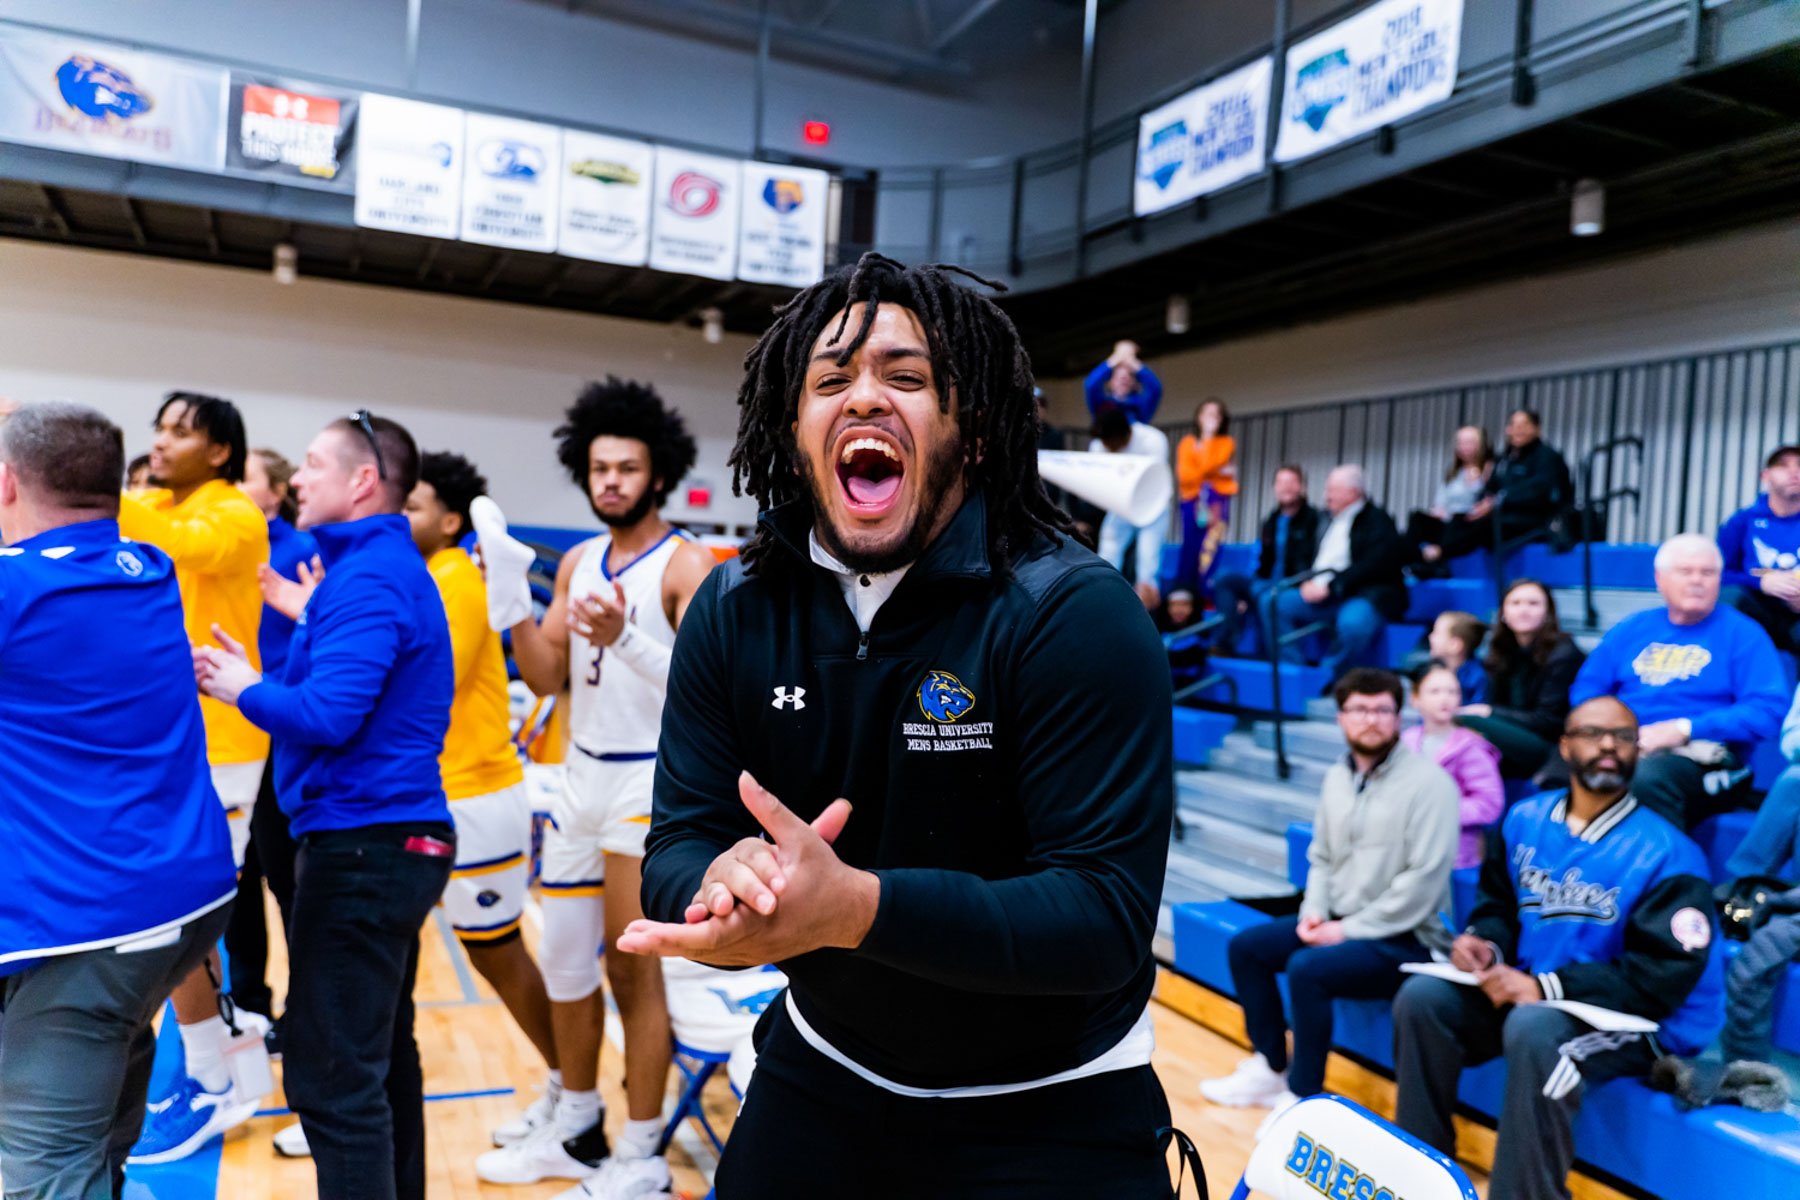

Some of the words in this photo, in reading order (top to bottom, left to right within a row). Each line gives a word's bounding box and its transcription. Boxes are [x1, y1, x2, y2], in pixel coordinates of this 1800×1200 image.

[902, 722, 938, 737] BRESCIA
[938, 722, 994, 737] UNIVERSITY
[906, 738, 932, 752] MENS
[933, 737, 994, 752] BASKETBALL
[1284, 1130, 1404, 1200] BRES
